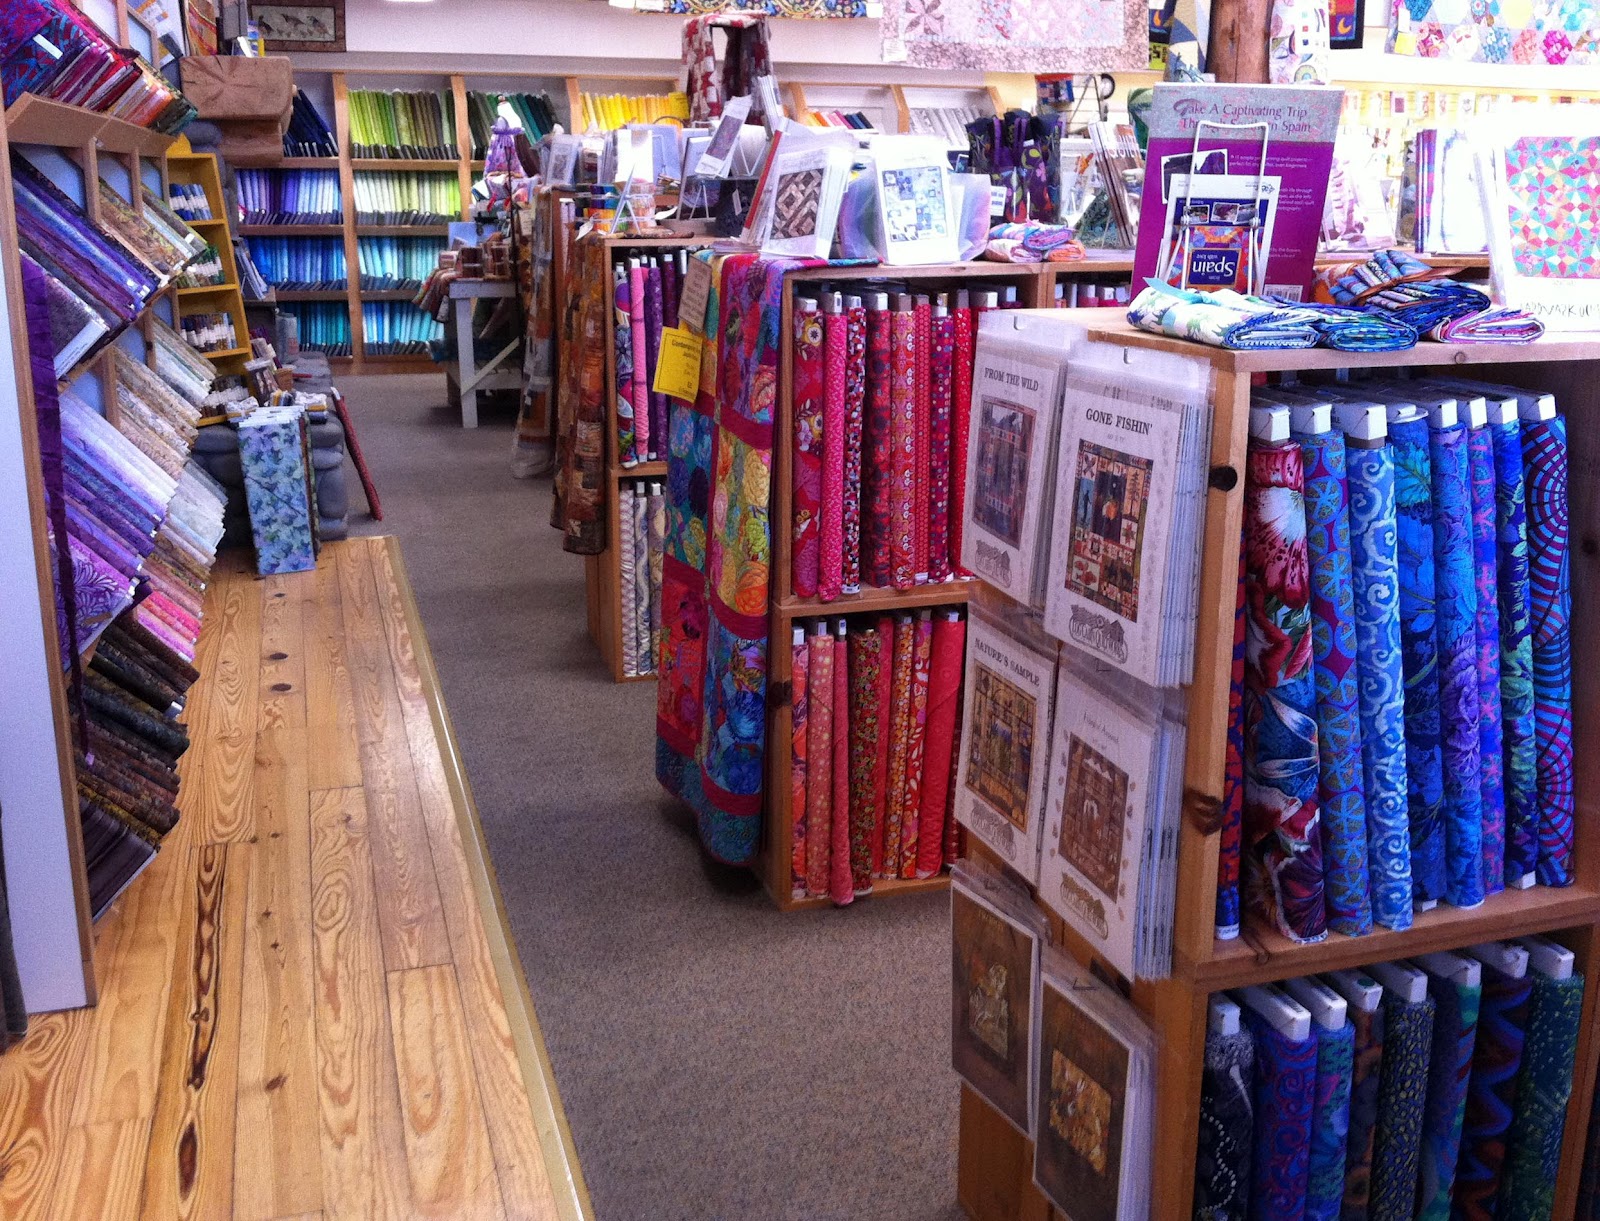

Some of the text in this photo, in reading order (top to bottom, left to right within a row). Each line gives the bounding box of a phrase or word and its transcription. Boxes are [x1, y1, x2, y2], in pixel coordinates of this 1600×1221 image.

[1208, 103, 1219, 114] A
[1222, 103, 1282, 120] Captivating
[1286, 105, 1308, 121] Trip
[1281, 121, 1311, 135] Spain
[1192, 256, 1236, 277] Spain
[984, 367, 1039, 391] FROM THE WILD
[1085, 408, 1113, 426] GONE
[974, 637, 1009, 667] NATURE'S
